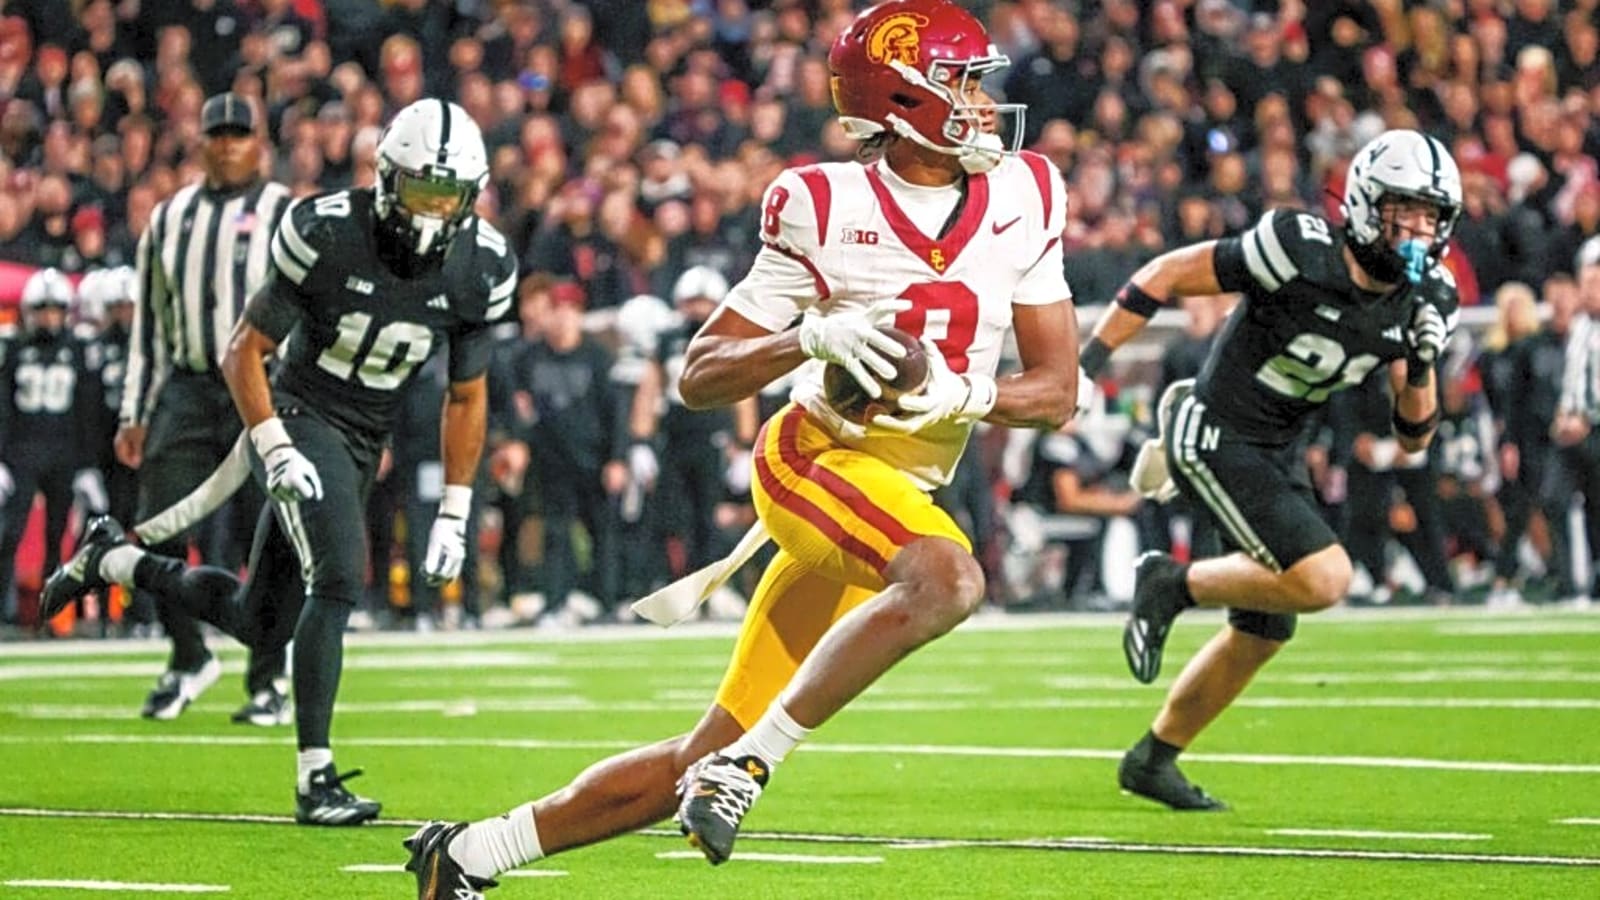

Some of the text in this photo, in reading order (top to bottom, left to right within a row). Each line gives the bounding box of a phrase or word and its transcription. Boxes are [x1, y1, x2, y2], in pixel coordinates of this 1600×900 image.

[315, 190, 351, 217] 10
[764, 186, 789, 238] 8
[841, 228, 879, 246] BIG
[1296, 213, 1333, 245] 21
[316, 311, 434, 390] 10
[1256, 333, 1380, 402] 21
[14, 362, 77, 413] 30
[1201, 425, 1220, 451] N
